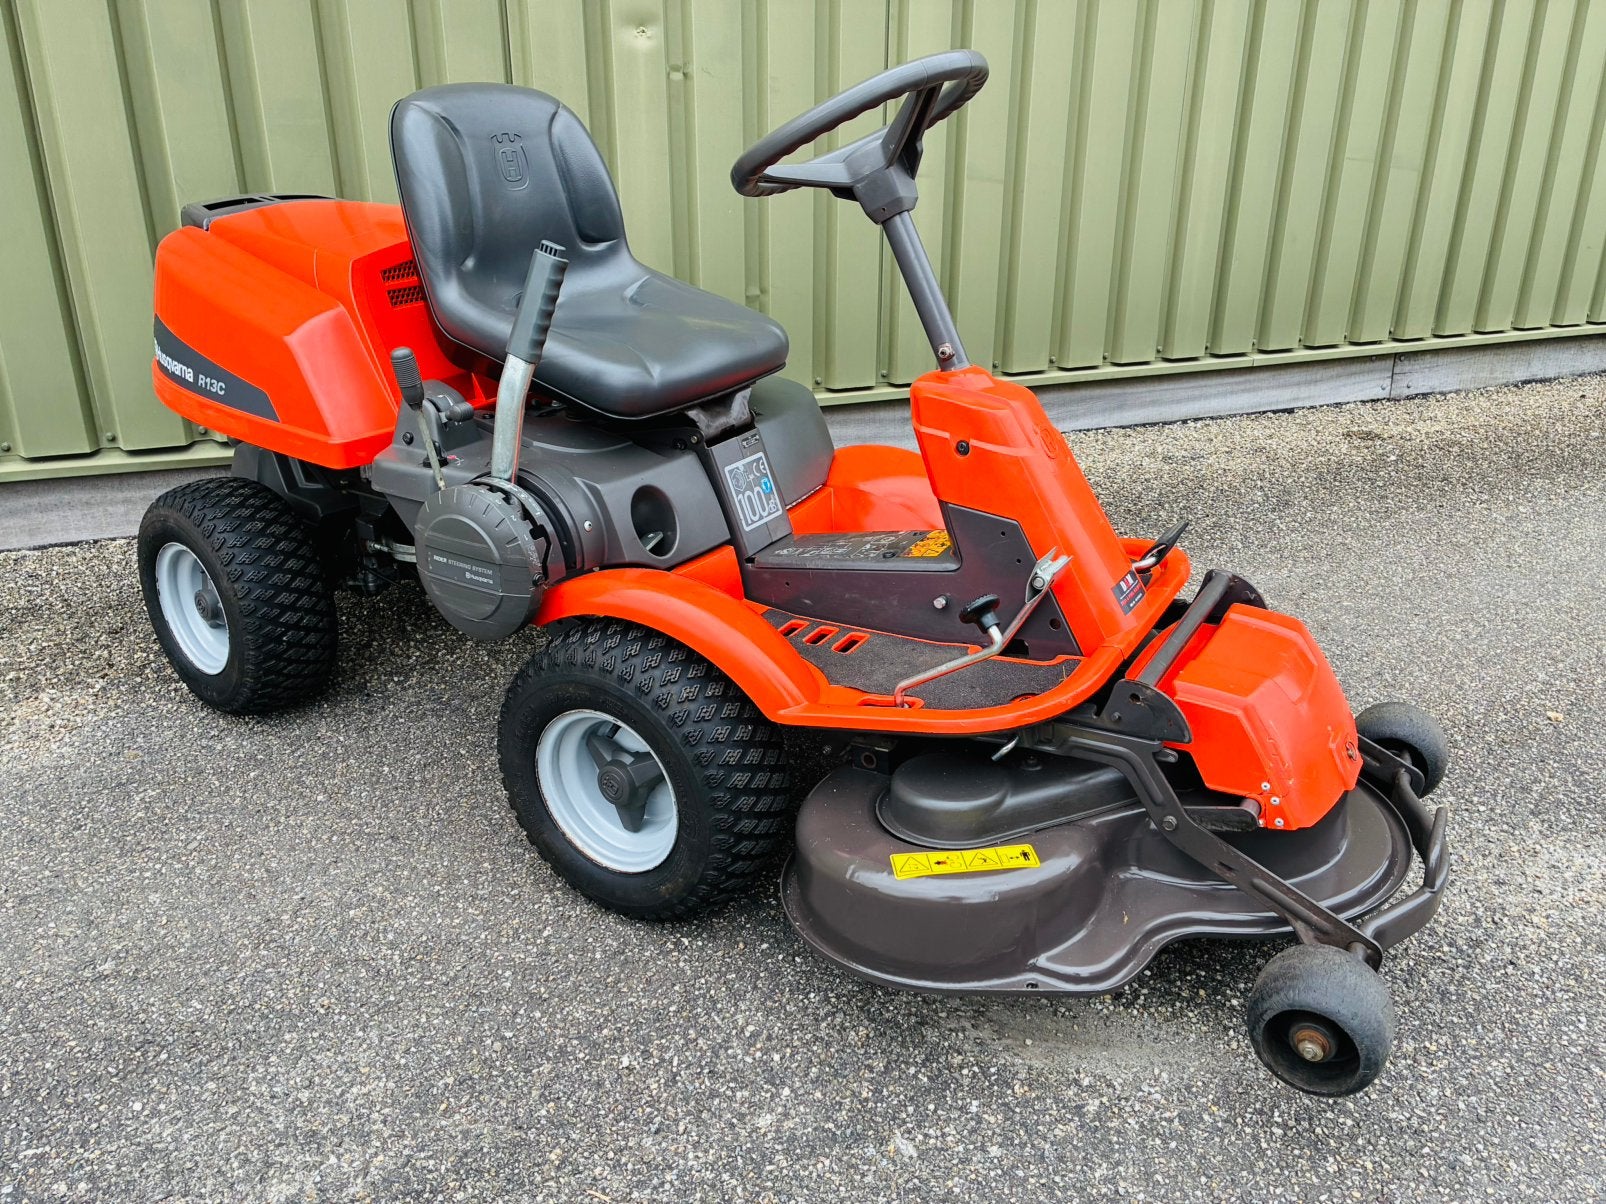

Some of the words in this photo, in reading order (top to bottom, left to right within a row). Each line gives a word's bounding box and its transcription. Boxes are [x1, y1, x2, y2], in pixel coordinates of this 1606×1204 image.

[198, 373, 226, 396] R13C
[737, 486, 769, 525] 100
[448, 559, 472, 570] STEERING
[472, 565, 493, 576] SYSTEM
